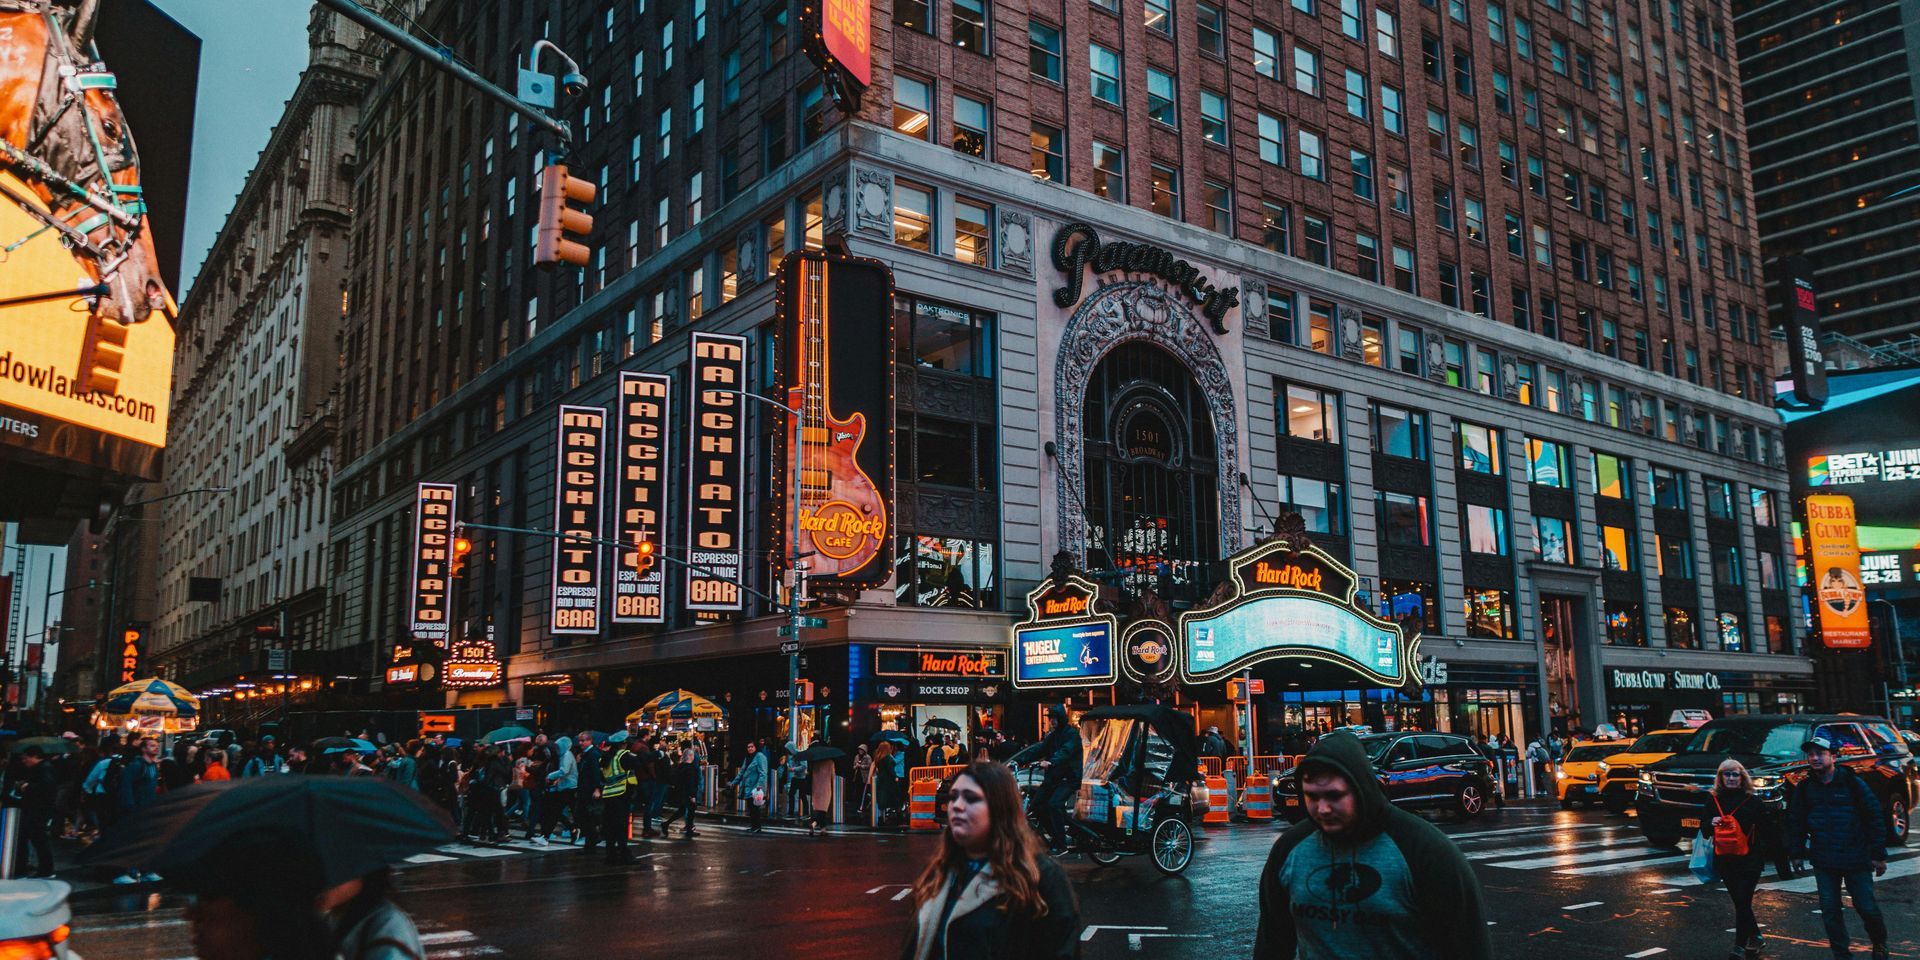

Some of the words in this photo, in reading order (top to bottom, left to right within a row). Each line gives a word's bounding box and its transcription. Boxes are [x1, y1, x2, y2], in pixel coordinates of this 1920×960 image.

[1052, 223, 1239, 335] Paramount
[696, 342, 741, 549] MACCHIATO
[1828, 453, 1868, 471] BET
[624, 380, 666, 567] MACCHIATO
[560, 412, 602, 583] MACCHIATO
[1809, 503, 1851, 519] BUBBA
[799, 508, 840, 532] Hard
[840, 512, 883, 540] Rock
[1815, 522, 1850, 538] GUMP
[825, 536, 853, 548] CAFE
[418, 489, 453, 621] MACCHIATO
[692, 552, 738, 565] ESPRESSO
[1861, 555, 1899, 571] JUNE
[618, 571, 661, 582] ESPSO
[1256, 562, 1291, 585] Hard
[1290, 565, 1322, 592] Rock
[1862, 570, 1901, 584] 25-28
[557, 587, 597, 597] ESPRESSO
[618, 583, 636, 593] AND
[637, 584, 660, 594] WINE
[691, 580, 738, 603] BAR
[557, 598, 574, 607] AND
[574, 598, 596, 608] WINE
[617, 596, 660, 616] BAR
[1045, 598, 1070, 614] Hard
[556, 609, 596, 628] BAR
[122, 631, 140, 681] PARK
[463, 648, 484, 658] 1501
[1131, 645, 1150, 655] Hard
[1150, 645, 1168, 655] Rock
[921, 654, 957, 672] Hard
[957, 655, 989, 676] Rock
[451, 668, 494, 680] Broadway
[1613, 669, 1642, 688] BUBBA
[1642, 670, 1666, 689] GUMP
[1674, 670, 1704, 689] SHRIMP
[919, 686, 944, 695] ROCK
[946, 686, 970, 695] SHOP
